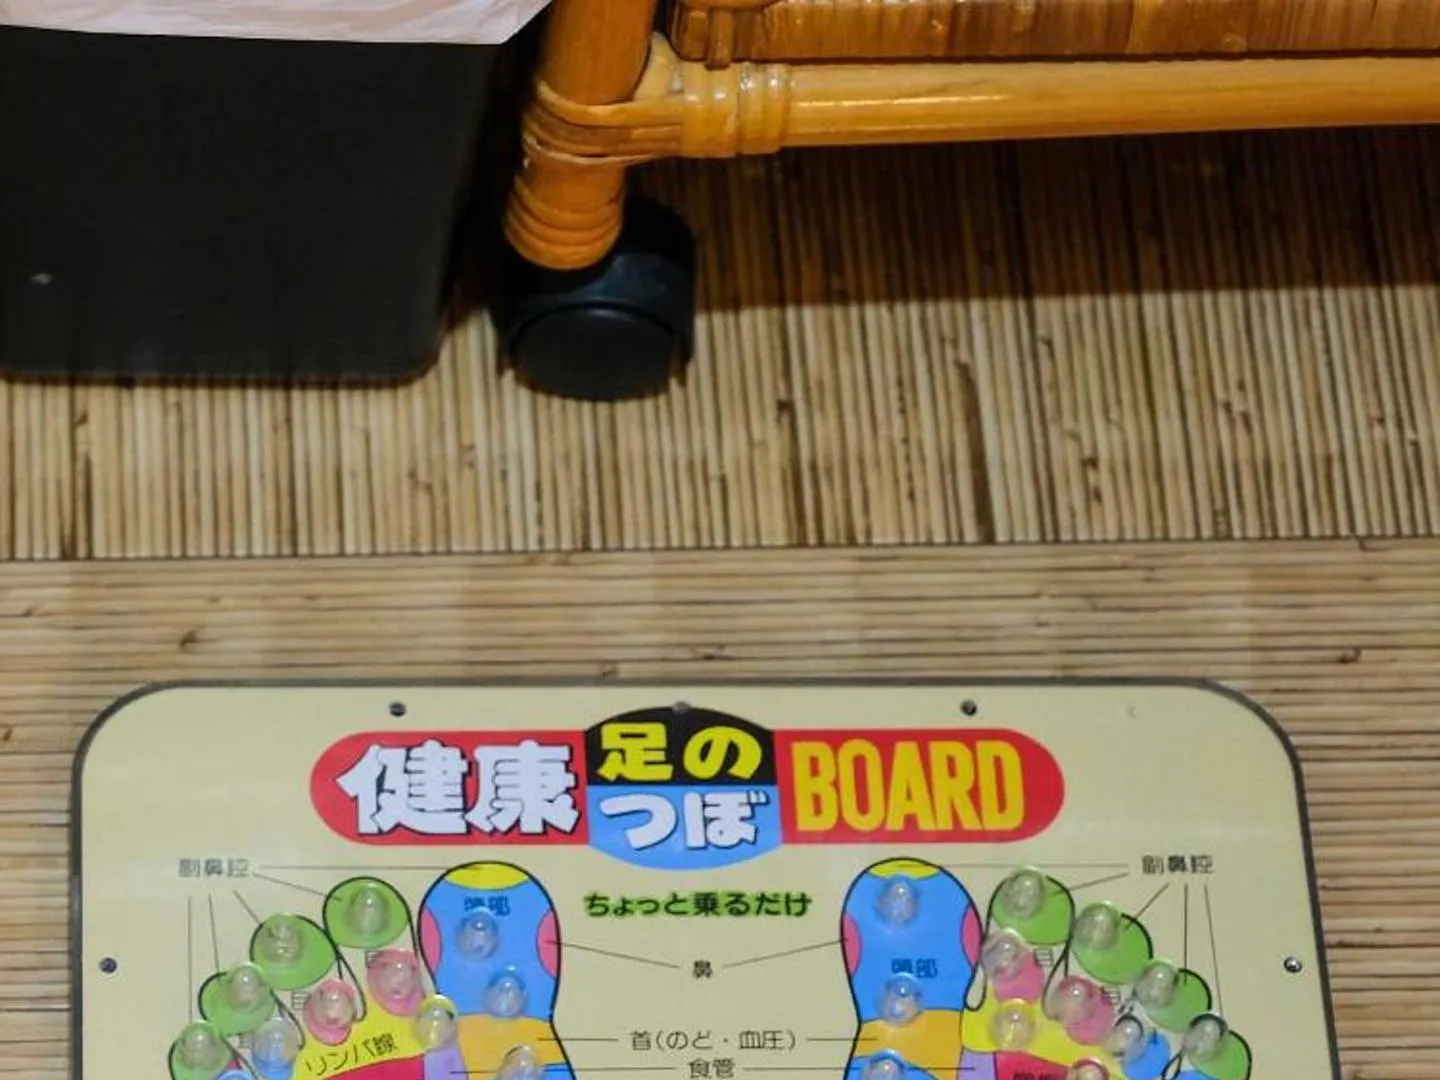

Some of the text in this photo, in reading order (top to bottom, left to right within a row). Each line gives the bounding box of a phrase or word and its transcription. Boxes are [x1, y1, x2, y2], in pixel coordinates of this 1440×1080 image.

[598, 723, 762, 781] 足の
[335, 738, 582, 836] 健康
[791, 740, 1025, 832] BOARD
[600, 790, 770, 850] つぼ
[584, 892, 812, 917] ちょっと乗るだけ
[689, 1058, 736, 1080] 食管
